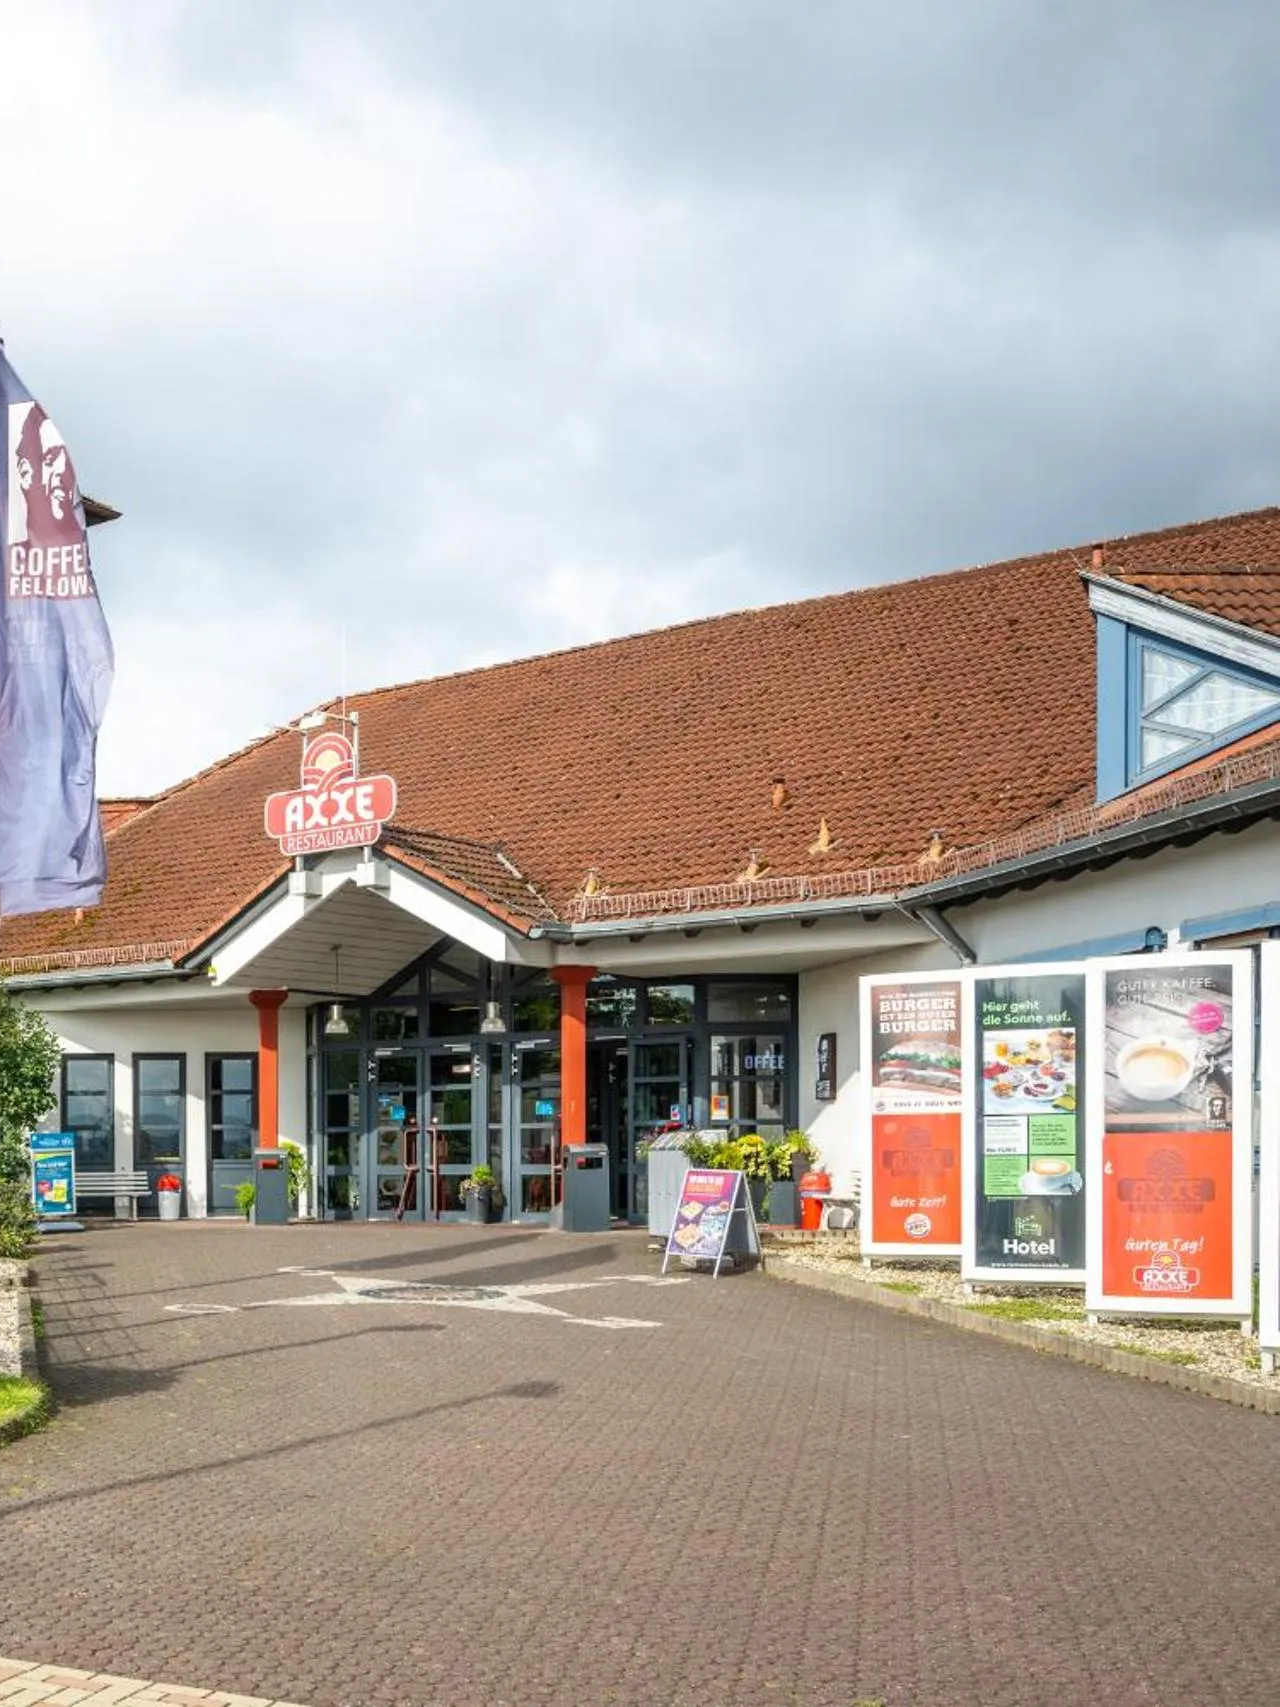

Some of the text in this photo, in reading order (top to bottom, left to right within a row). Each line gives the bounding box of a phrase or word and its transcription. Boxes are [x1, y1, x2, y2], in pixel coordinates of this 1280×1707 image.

[10, 542, 87, 576] COFFE
[285, 785, 375, 833] AXXE
[287, 825, 373, 852] RESTAURANT
[879, 998, 957, 1013] BURGER
[983, 1000, 1040, 1013] Hier geht
[983, 1010, 1072, 1025] die Sonne auf.
[879, 1018, 957, 1034] BURGER
[1003, 1239, 1056, 1255] Hotel
[1143, 1268, 1188, 1284] AXXE
